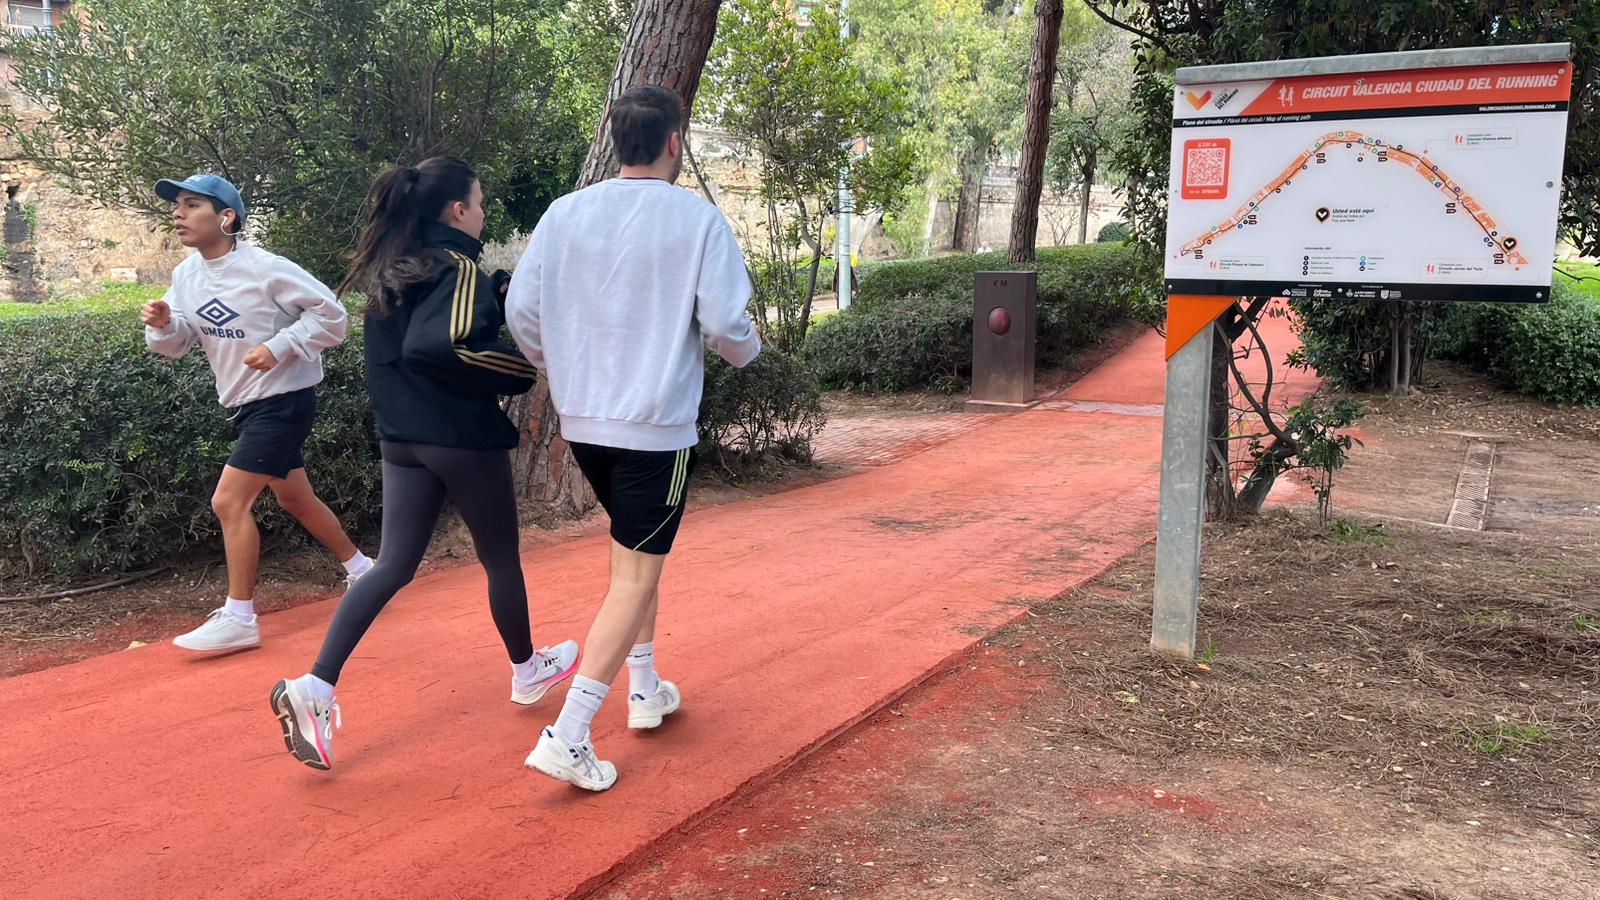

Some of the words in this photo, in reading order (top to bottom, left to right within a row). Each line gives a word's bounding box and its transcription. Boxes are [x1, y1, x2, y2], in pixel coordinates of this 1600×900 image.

[1302, 84, 1351, 99] CIRCUIT
[1352, 81, 1412, 97] VALENCIA
[1415, 78, 1464, 93] CIUDAD
[1467, 77, 1492, 90] DEL
[1495, 74, 1559, 89] RUNNING
[200, 326, 245, 339] UMBRO
